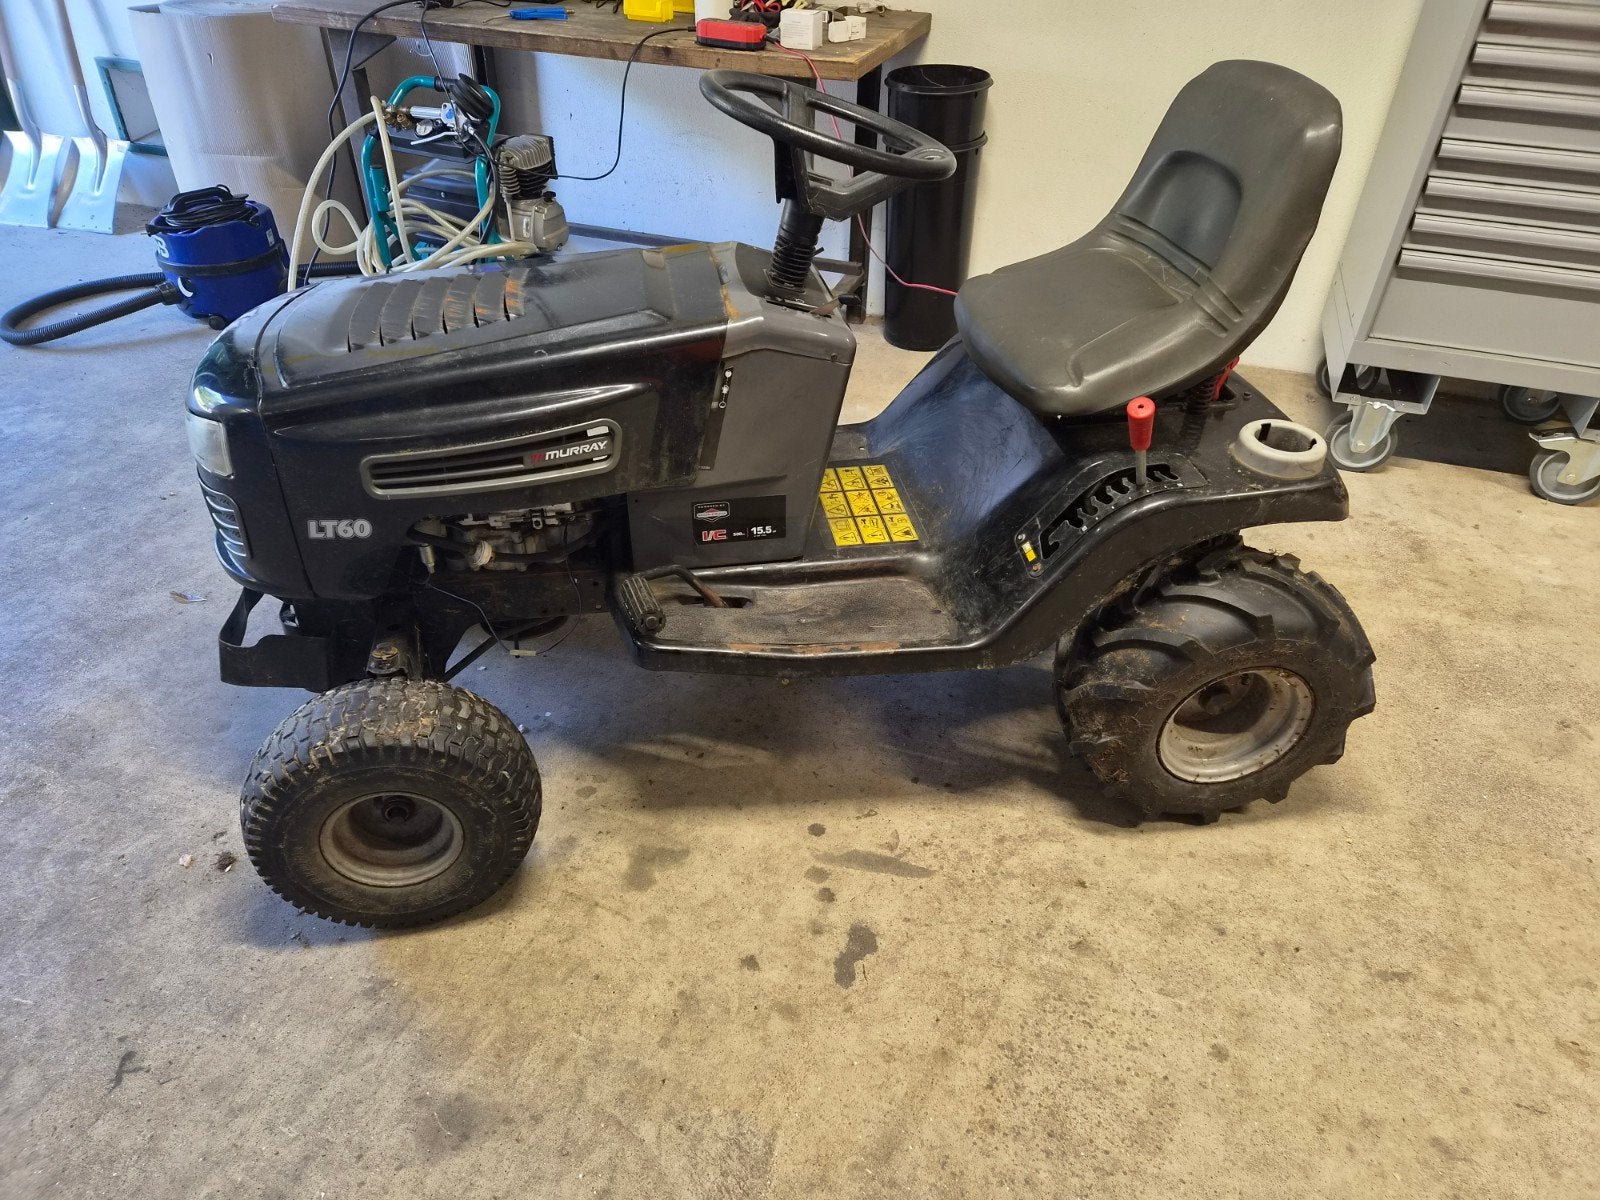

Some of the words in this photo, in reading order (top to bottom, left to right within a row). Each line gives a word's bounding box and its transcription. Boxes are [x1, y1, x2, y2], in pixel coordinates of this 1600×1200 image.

[545, 440, 607, 460] MURRAY
[307, 518, 373, 539] LT60
[750, 525, 772, 535] 15.5
